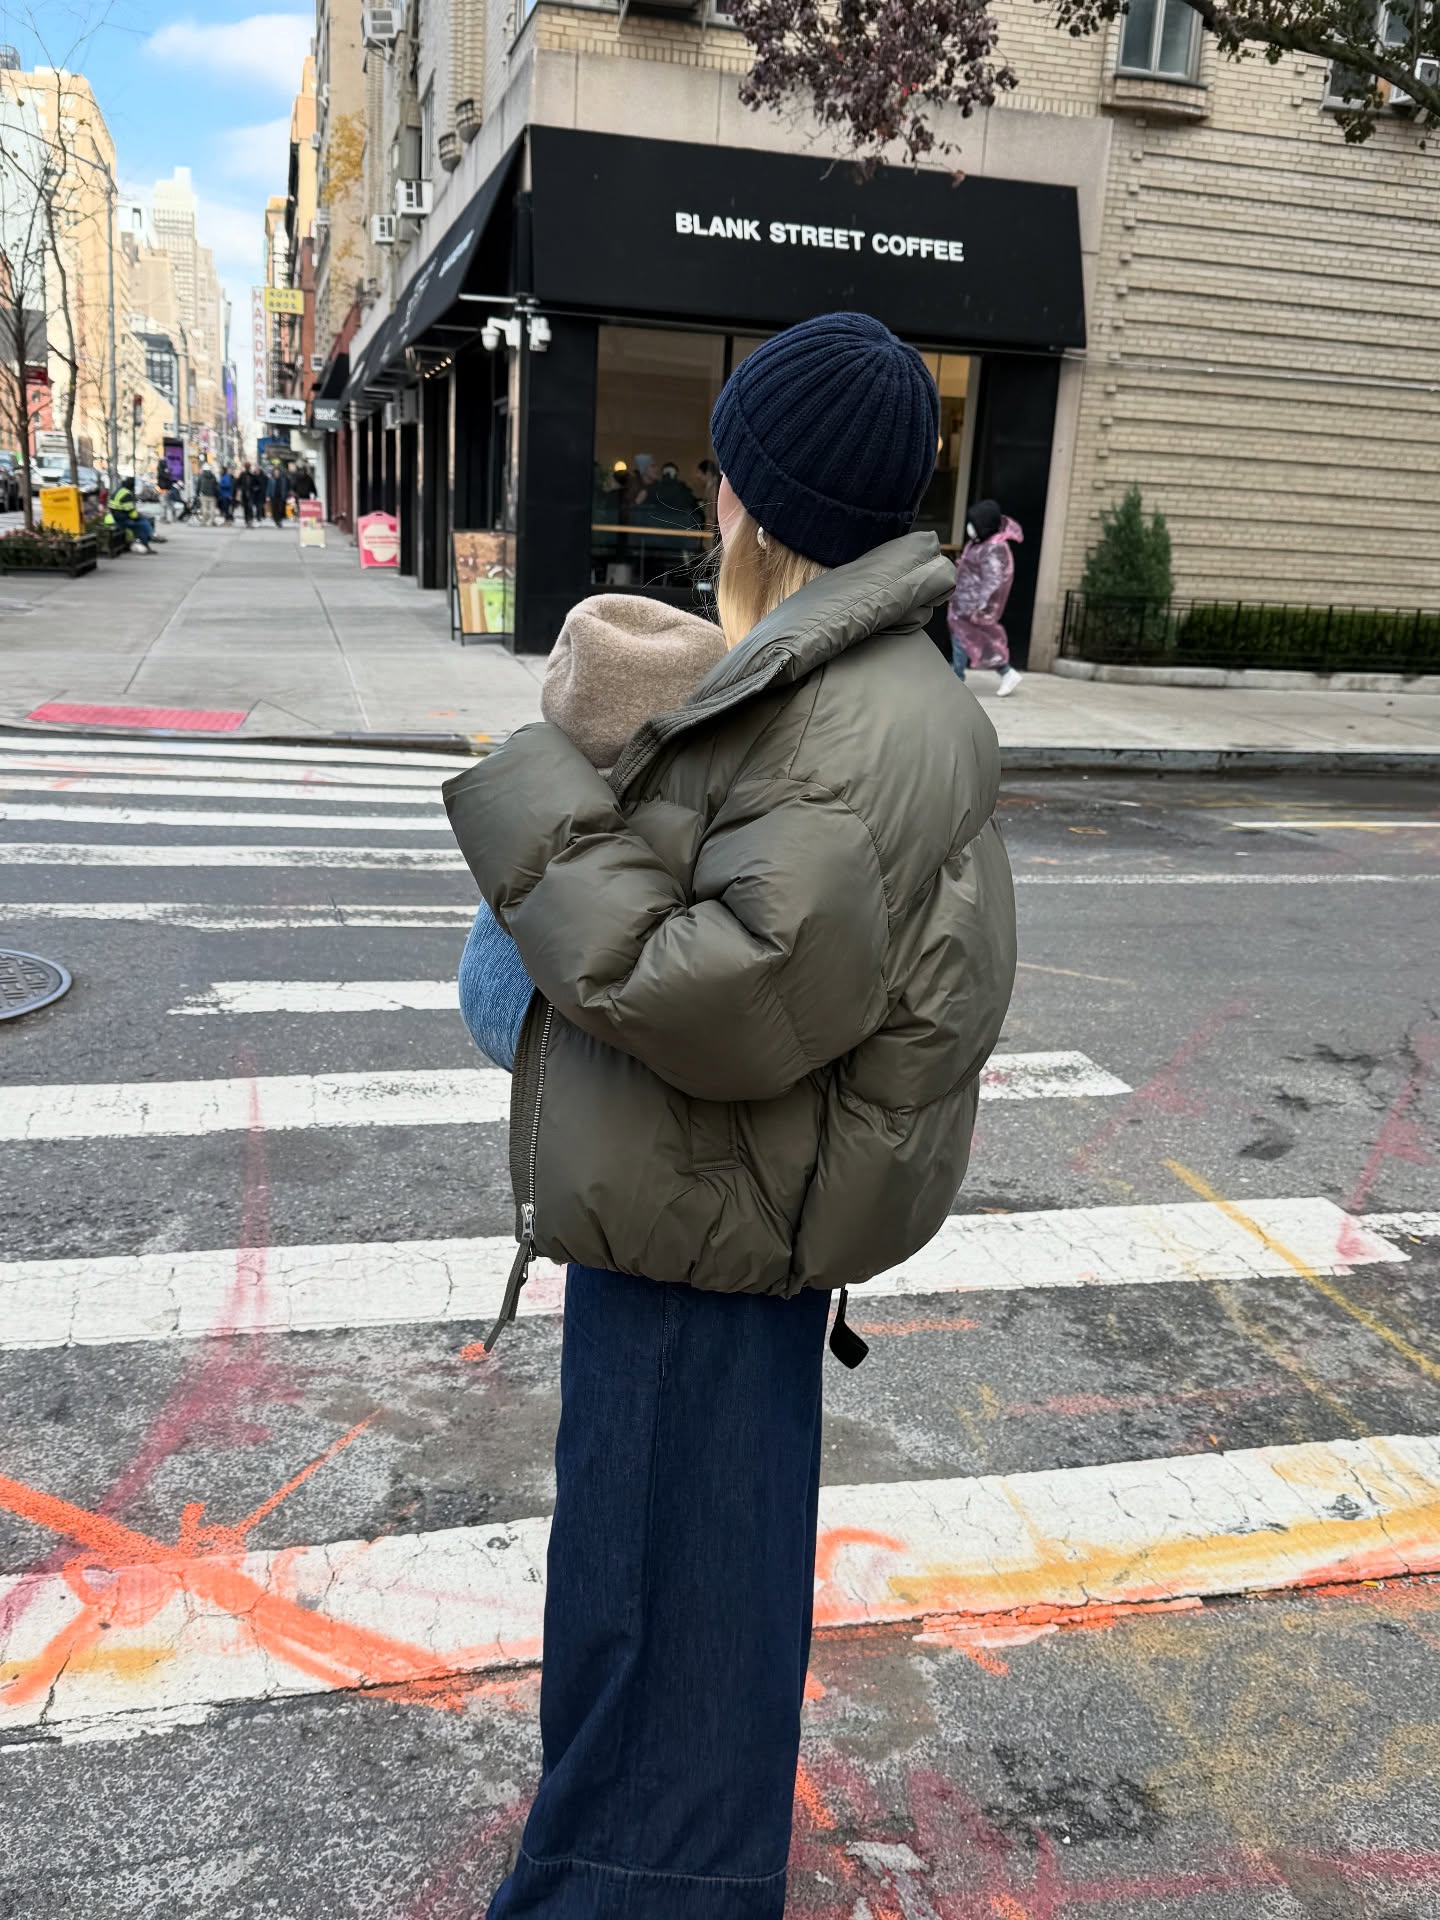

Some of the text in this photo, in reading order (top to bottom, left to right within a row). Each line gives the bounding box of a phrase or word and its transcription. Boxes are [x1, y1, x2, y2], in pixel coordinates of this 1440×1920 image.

[676, 212, 964, 262] BLANK STREET COFFEE
[253, 290, 265, 417] HARDWARE
